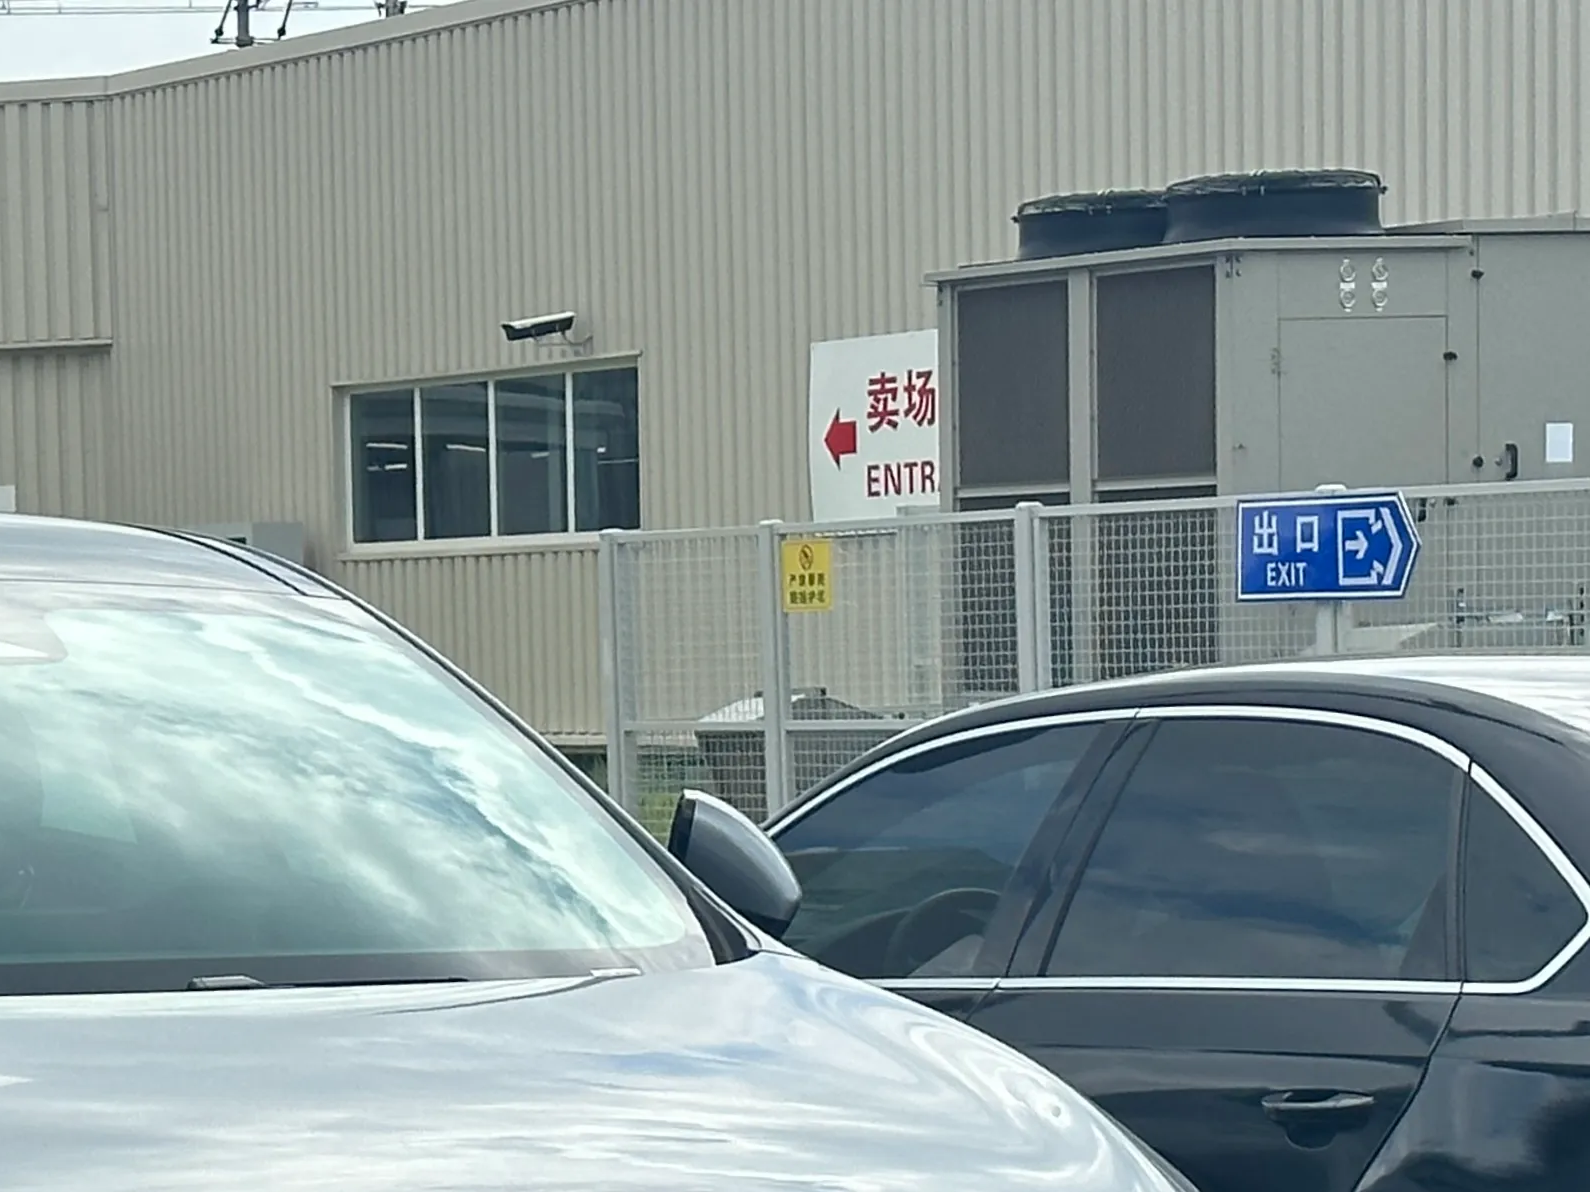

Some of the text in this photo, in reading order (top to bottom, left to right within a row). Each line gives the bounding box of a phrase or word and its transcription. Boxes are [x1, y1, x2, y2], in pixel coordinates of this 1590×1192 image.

[866, 369, 936, 433] 卖场
[866, 460, 940, 498] ENTR
[1252, 510, 1320, 556] 出口
[1266, 561, 1307, 587] EXIT
